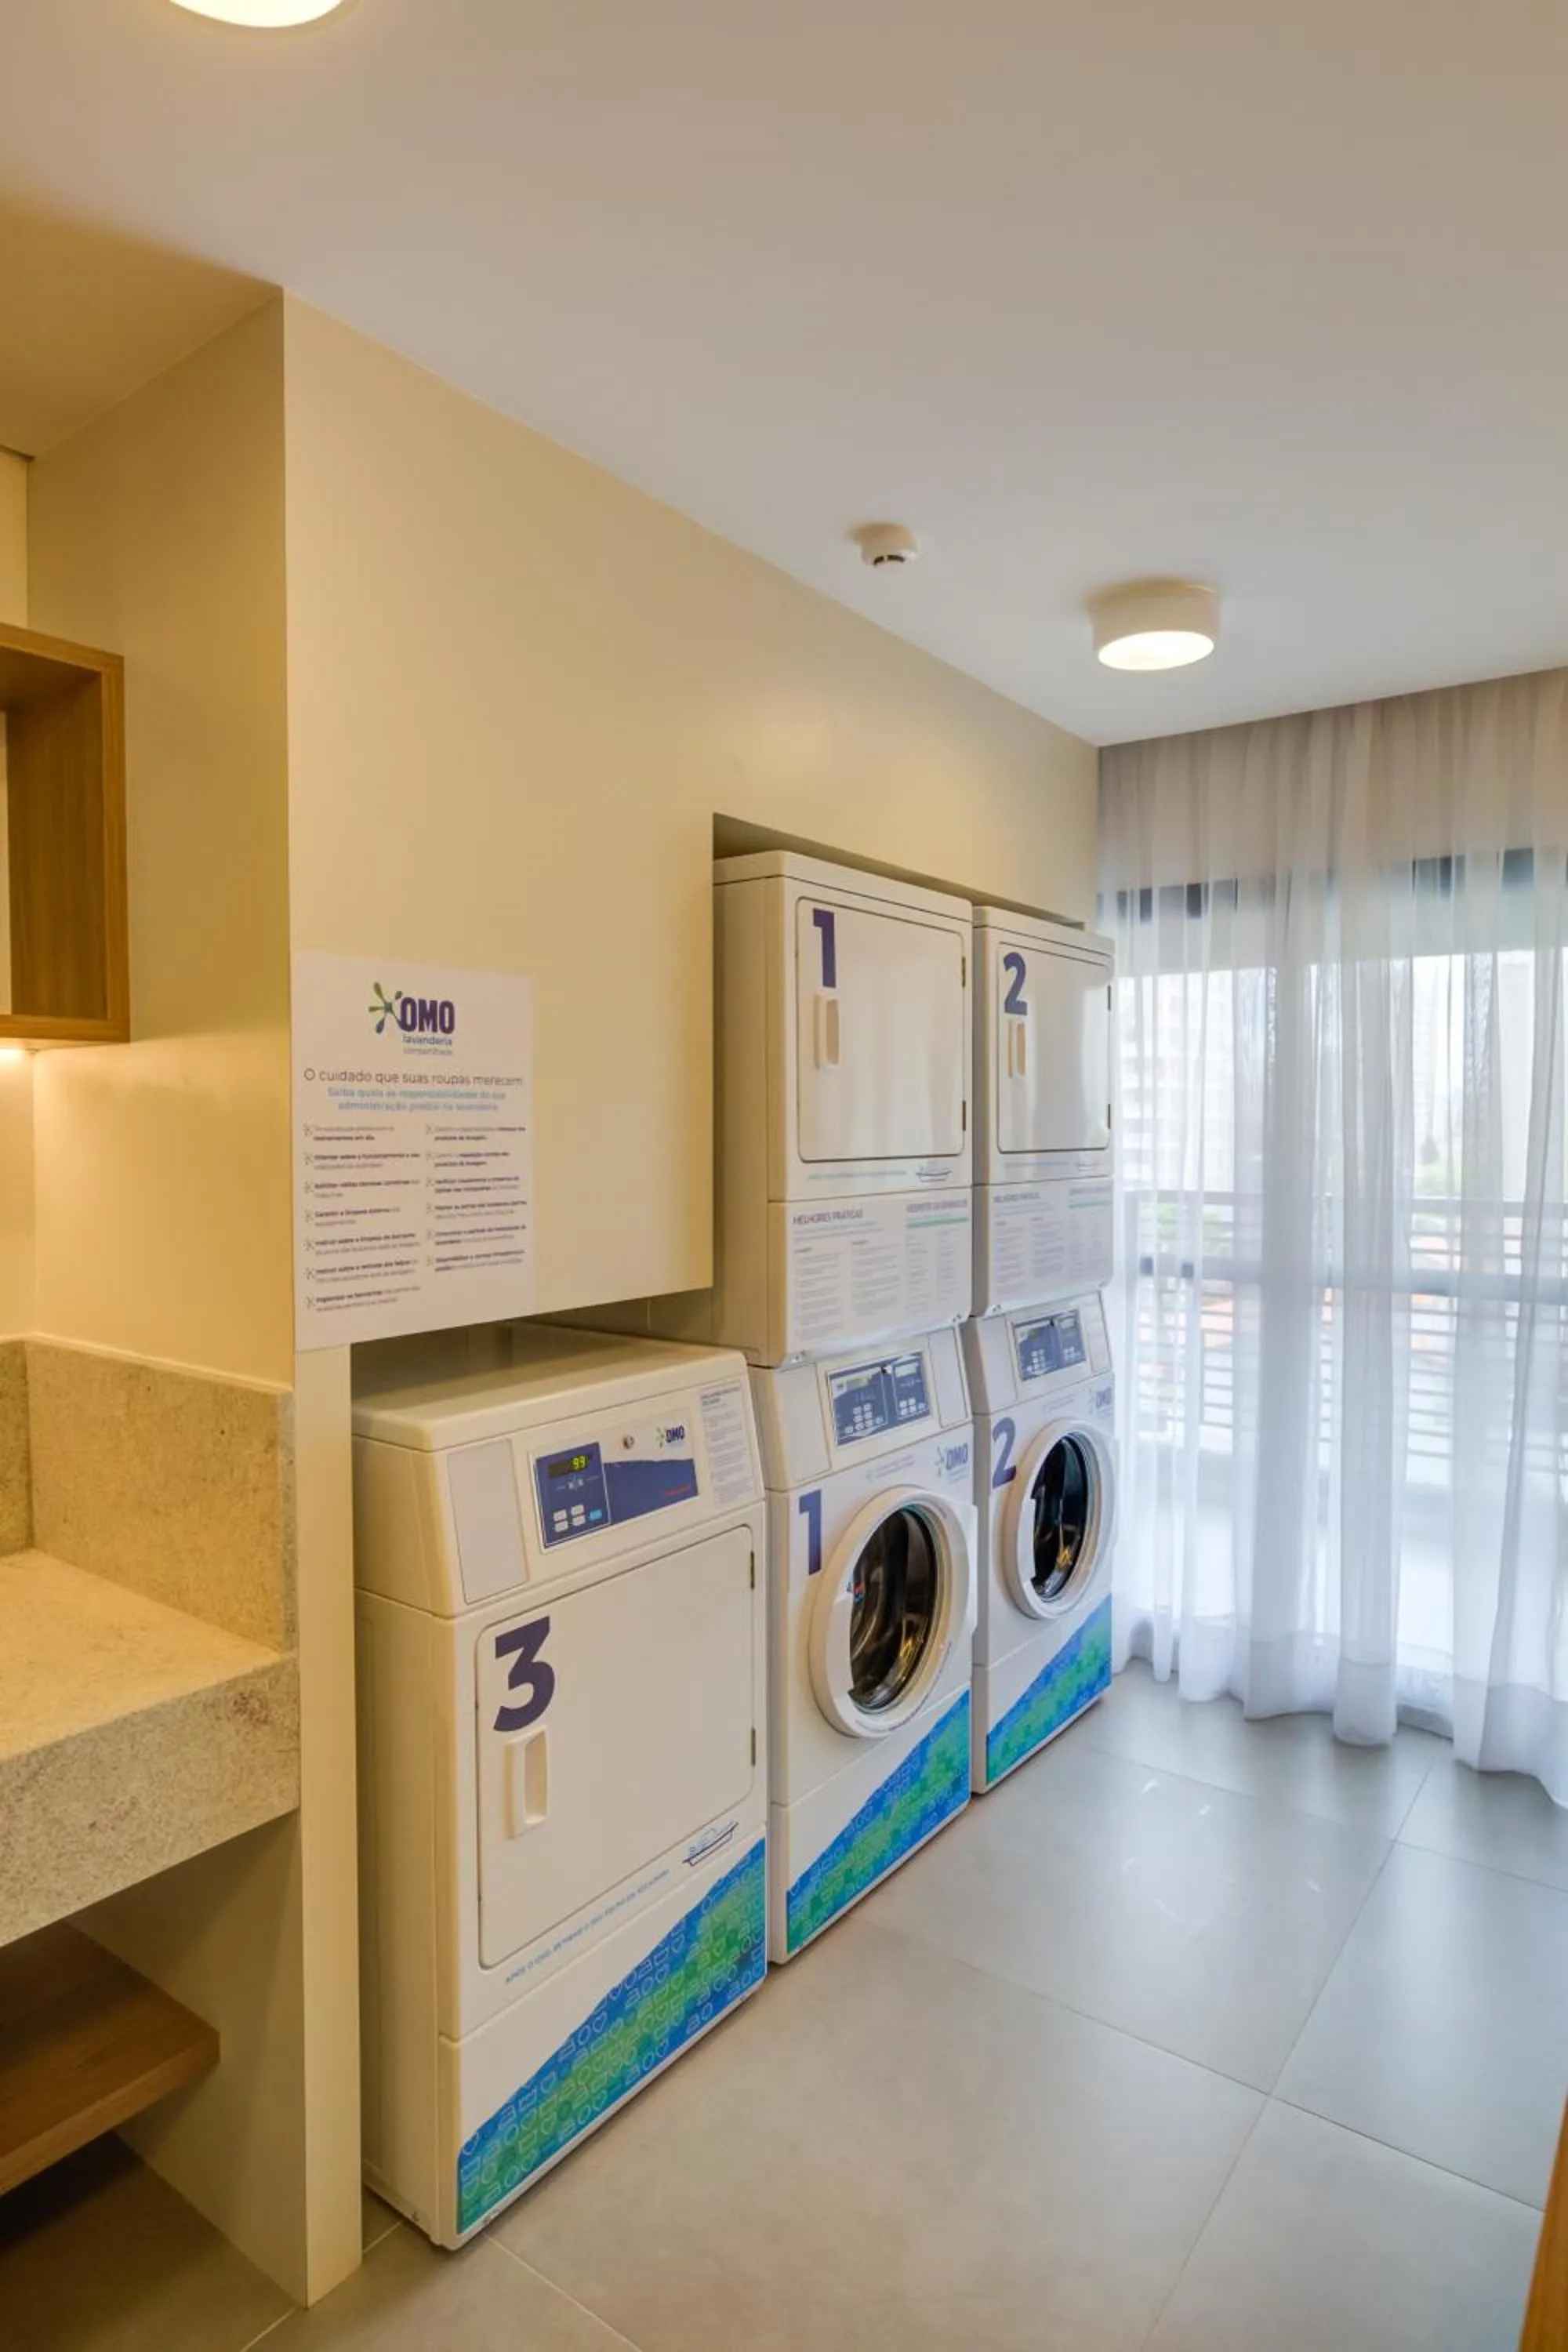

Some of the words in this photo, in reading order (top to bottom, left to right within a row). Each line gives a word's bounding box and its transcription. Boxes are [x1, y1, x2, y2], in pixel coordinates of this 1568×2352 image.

[813, 907, 837, 989] 1
[401, 996, 455, 1034] OMO
[1003, 952, 1028, 1016] 2
[402, 1035, 452, 1046] lavanderia
[303, 1068, 316, 1081] O
[319, 1070, 372, 1082] cuidado
[375, 1073, 400, 1085] que
[402, 1074, 429, 1084] suas
[431, 1075, 471, 1087] roupas
[473, 1076, 523, 1087] merecem
[993, 1416, 1017, 1490] 2
[799, 1489, 822, 1576] 1
[493, 1615, 556, 1733] 3
